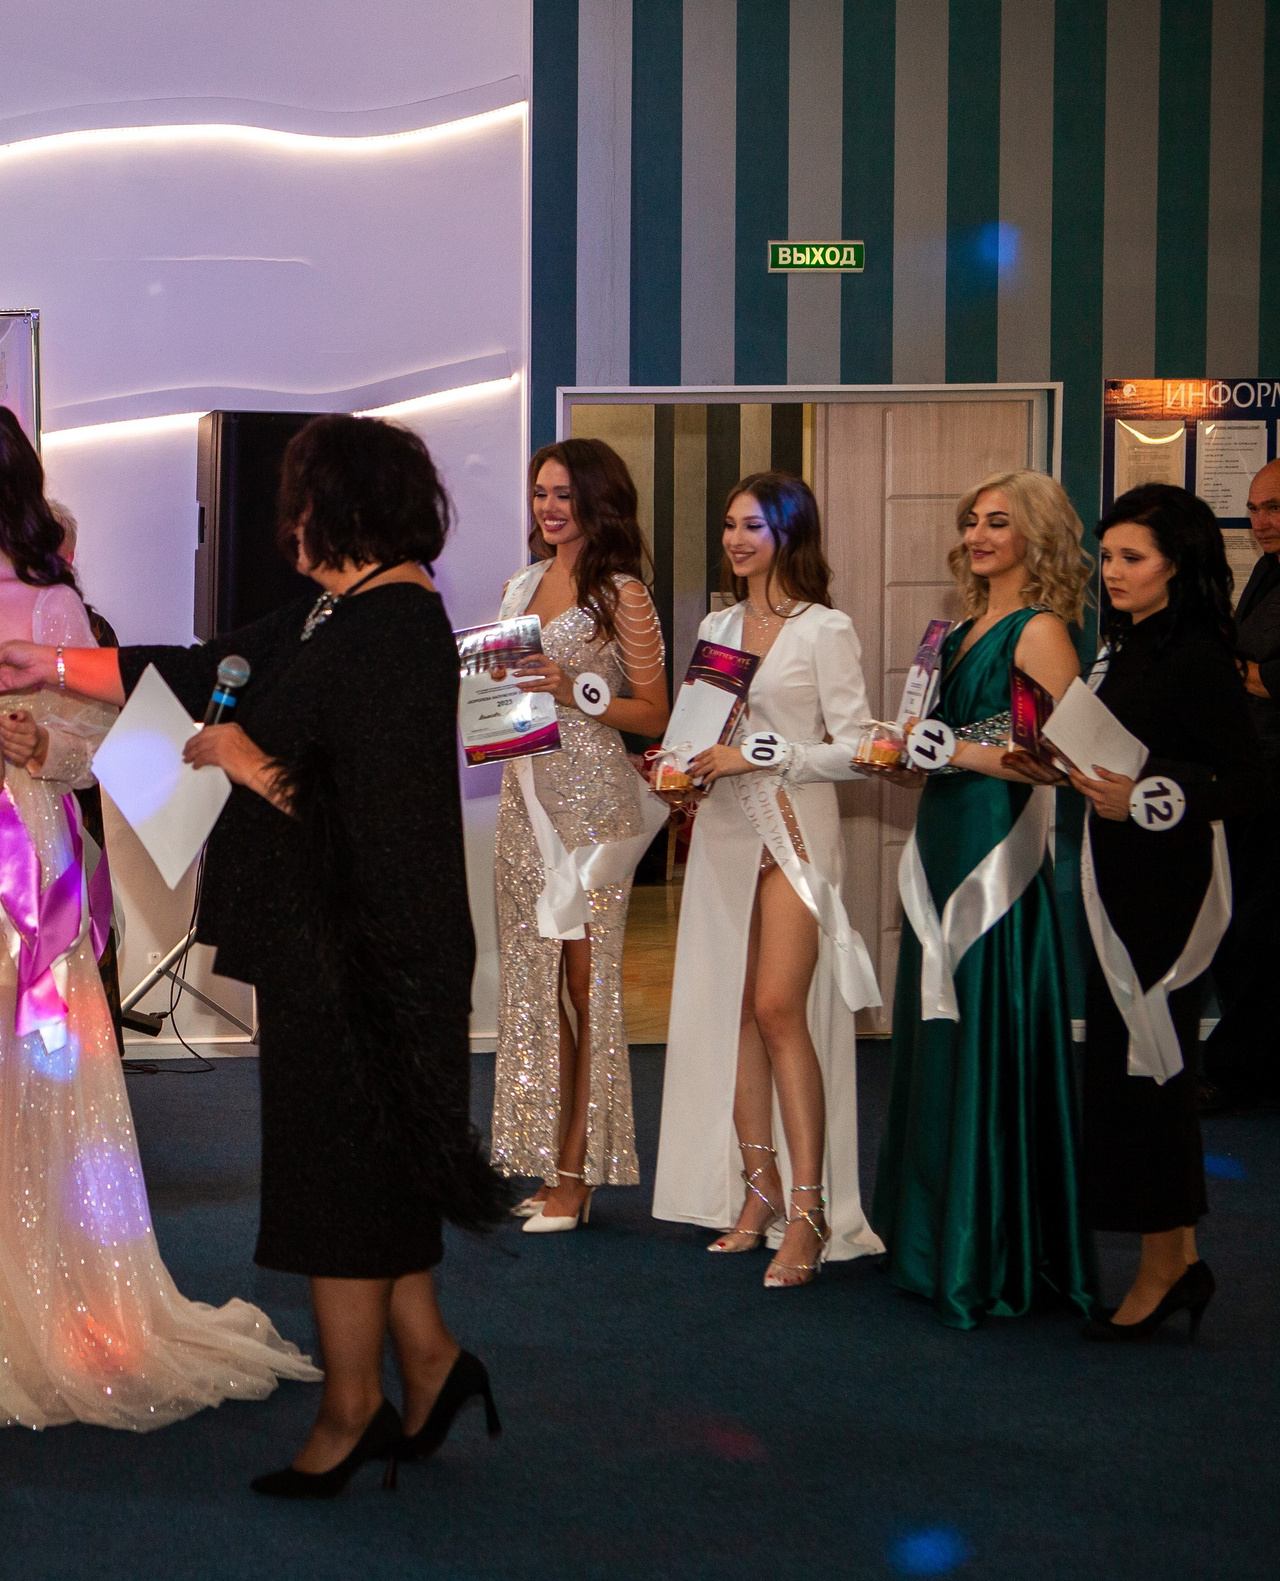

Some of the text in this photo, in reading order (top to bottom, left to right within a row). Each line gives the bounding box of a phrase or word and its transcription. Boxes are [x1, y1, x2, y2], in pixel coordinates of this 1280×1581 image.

[778, 247, 856, 266] ВЫХОД
[752, 735, 778, 761] 10
[914, 729, 946, 762] 11
[1143, 781, 1173, 825] 12
